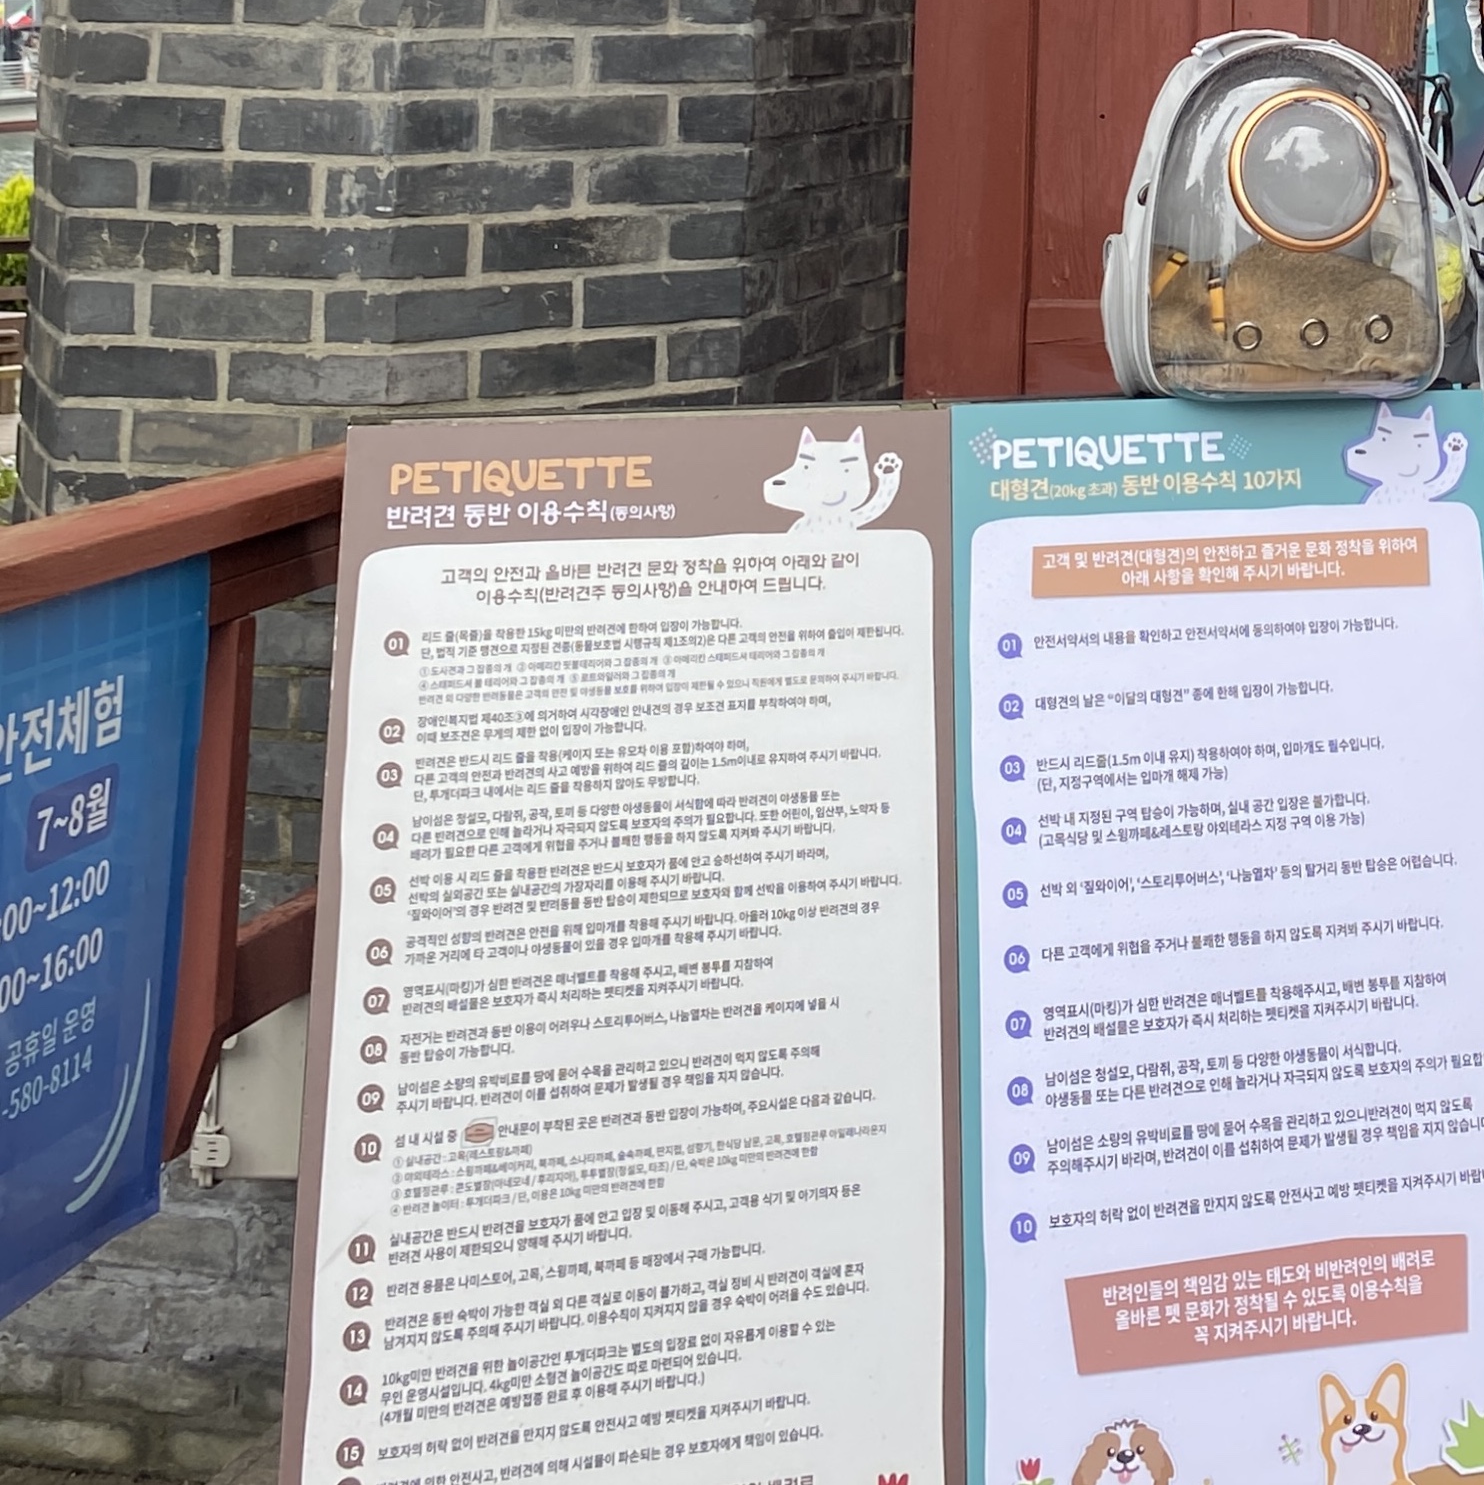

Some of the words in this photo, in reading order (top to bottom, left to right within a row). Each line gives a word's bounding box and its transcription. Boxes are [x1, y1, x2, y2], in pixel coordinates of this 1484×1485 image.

[992, 431, 1225, 471] PETIQUETTE
[390, 455, 653, 497] PETIQUETTE
[1122, 473, 1159, 497] 동반
[1163, 470, 1236, 494] 이용수칙
[1244, 468, 1301, 490] 10가지
[387, 504, 455, 530] 반려견
[464, 503, 511, 528] 동반
[441, 567, 488, 584] 고객의
[494, 566, 541, 583] 안전과
[546, 563, 591, 581] 올바른
[597, 561, 641, 579] 반려견
[648, 560, 678, 577] 문화
[683, 557, 727, 576] 정착을
[733, 556, 776, 573] 위하여
[782, 553, 826, 571] 아래와
[831, 552, 858, 569] 같이
[1044, 552, 1069, 569] 고객
[1075, 551, 1087, 569] 및
[1204, 544, 1257, 563] 안전하고
[1262, 542, 1300, 560] 즐거운
[1306, 540, 1331, 558] 문화
[1336, 539, 1373, 556] 정착을
[1379, 537, 1417, 554] 위하여
[612, 581, 692, 601] 동의사항)을
[698, 578, 757, 596] 안내하여
[1122, 570, 1149, 587] 아래
[1154, 568, 1193, 585] 사항을
[1199, 565, 1238, 583] 확인해
[1244, 564, 1282, 581] 주시기
[1288, 561, 1344, 578] 바랍니다.
[1002, 638, 1018, 653] 01
[1034, 632, 1100, 650] 안전서약서의
[1104, 630, 1135, 645] 내용을
[1140, 628, 1182, 643] 확인하고
[1185, 624, 1249, 641] 안전서약서에
[1253, 621, 1305, 638] 동의하여야
[1309, 619, 1339, 635] 입장이
[1343, 617, 1397, 632] 가능합니다.
[1003, 699, 1020, 714] 02
[1035, 694, 1079, 711] 대형견의
[1083, 693, 1104, 708] 날은
[1193, 686, 1213, 702] 중에
[1217, 685, 1238, 700] 한해
[1242, 683, 1273, 698] 입장이
[1277, 680, 1332, 696] 가능합니다.
[1004, 761, 1020, 775] 03
[1037, 756, 1070, 773] 반드시
[1144, 750, 1165, 765] 이내
[1169, 748, 1194, 764] 유지)
[1198, 745, 1251, 761] 착용하여야
[1255, 743, 1280, 759] 하며,
[1282, 740, 1325, 756] 입마개도
[1328, 736, 1384, 753] 필수입니다.
[1038, 777, 1056, 793] (단,
[1059, 772, 1137, 790] 지정구역에서는
[1141, 768, 1173, 785] 입마개
[1177, 767, 1199, 783] 해제
[1202, 765, 1227, 781] 가능)
[37, 777, 112, 852] 7~8월
[1005, 824, 1022, 838] 04
[1038, 813, 1061, 829] 선박
[1064, 811, 1075, 826] 내
[1079, 809, 1112, 825] 지정된
[1115, 808, 1137, 823] 구역
[1141, 805, 1174, 821] 탑승이
[1178, 801, 1225, 818] 가능하며,
[1228, 799, 1249, 816] 실내
[1253, 798, 1274, 814] 공간
[1277, 795, 1309, 812] 입장은
[1313, 792, 1369, 809] 불가합니다.
[1039, 831, 1088, 850] (고목식당
[1092, 829, 1102, 845] 및
[1207, 819, 1262, 836] 야외테라스
[1265, 816, 1286, 832] 지정
[1291, 814, 1311, 830] 구역
[1315, 813, 1336, 828] 이용
[1340, 811, 1364, 827] 가능)
[1007, 887, 1024, 902] 05
[1041, 881, 1062, 899] 선박
[1066, 880, 1077, 896] 외
[1281, 863, 1301, 880] 등의
[1341, 860, 1362, 875] 동반
[1366, 857, 1397, 873] 탑승은
[1401, 852, 1456, 869] 어렵습니다.
[5, 1017, 58, 1078] 공휴일
[62, 995, 97, 1044] 운영
[351, 1286, 369, 1302] 12
[1103, 1279, 1178, 1306] 반려인들의
[1184, 1273, 1228, 1296] 책임감
[1233, 1270, 1261, 1291] 있는
[1267, 1263, 1310, 1286] 태도와
[1315, 1255, 1387, 1280] 비반려인의
[1392, 1249, 1434, 1271] 배려로
[1116, 1305, 1161, 1330] 올바른
[1166, 1303, 1180, 1324] 펫
[1186, 1298, 1229, 1321] 문화가
[1235, 1292, 1277, 1316] 정착될
[1284, 1290, 1297, 1310] 수
[1302, 1283, 1345, 1307] 있도록
[1351, 1275, 1422, 1300] 이용수칙을
[1195, 1325, 1209, 1345] 꼭
[1214, 1315, 1287, 1342] 지켜주시기
[1293, 1308, 1356, 1332] 바랍니다.
